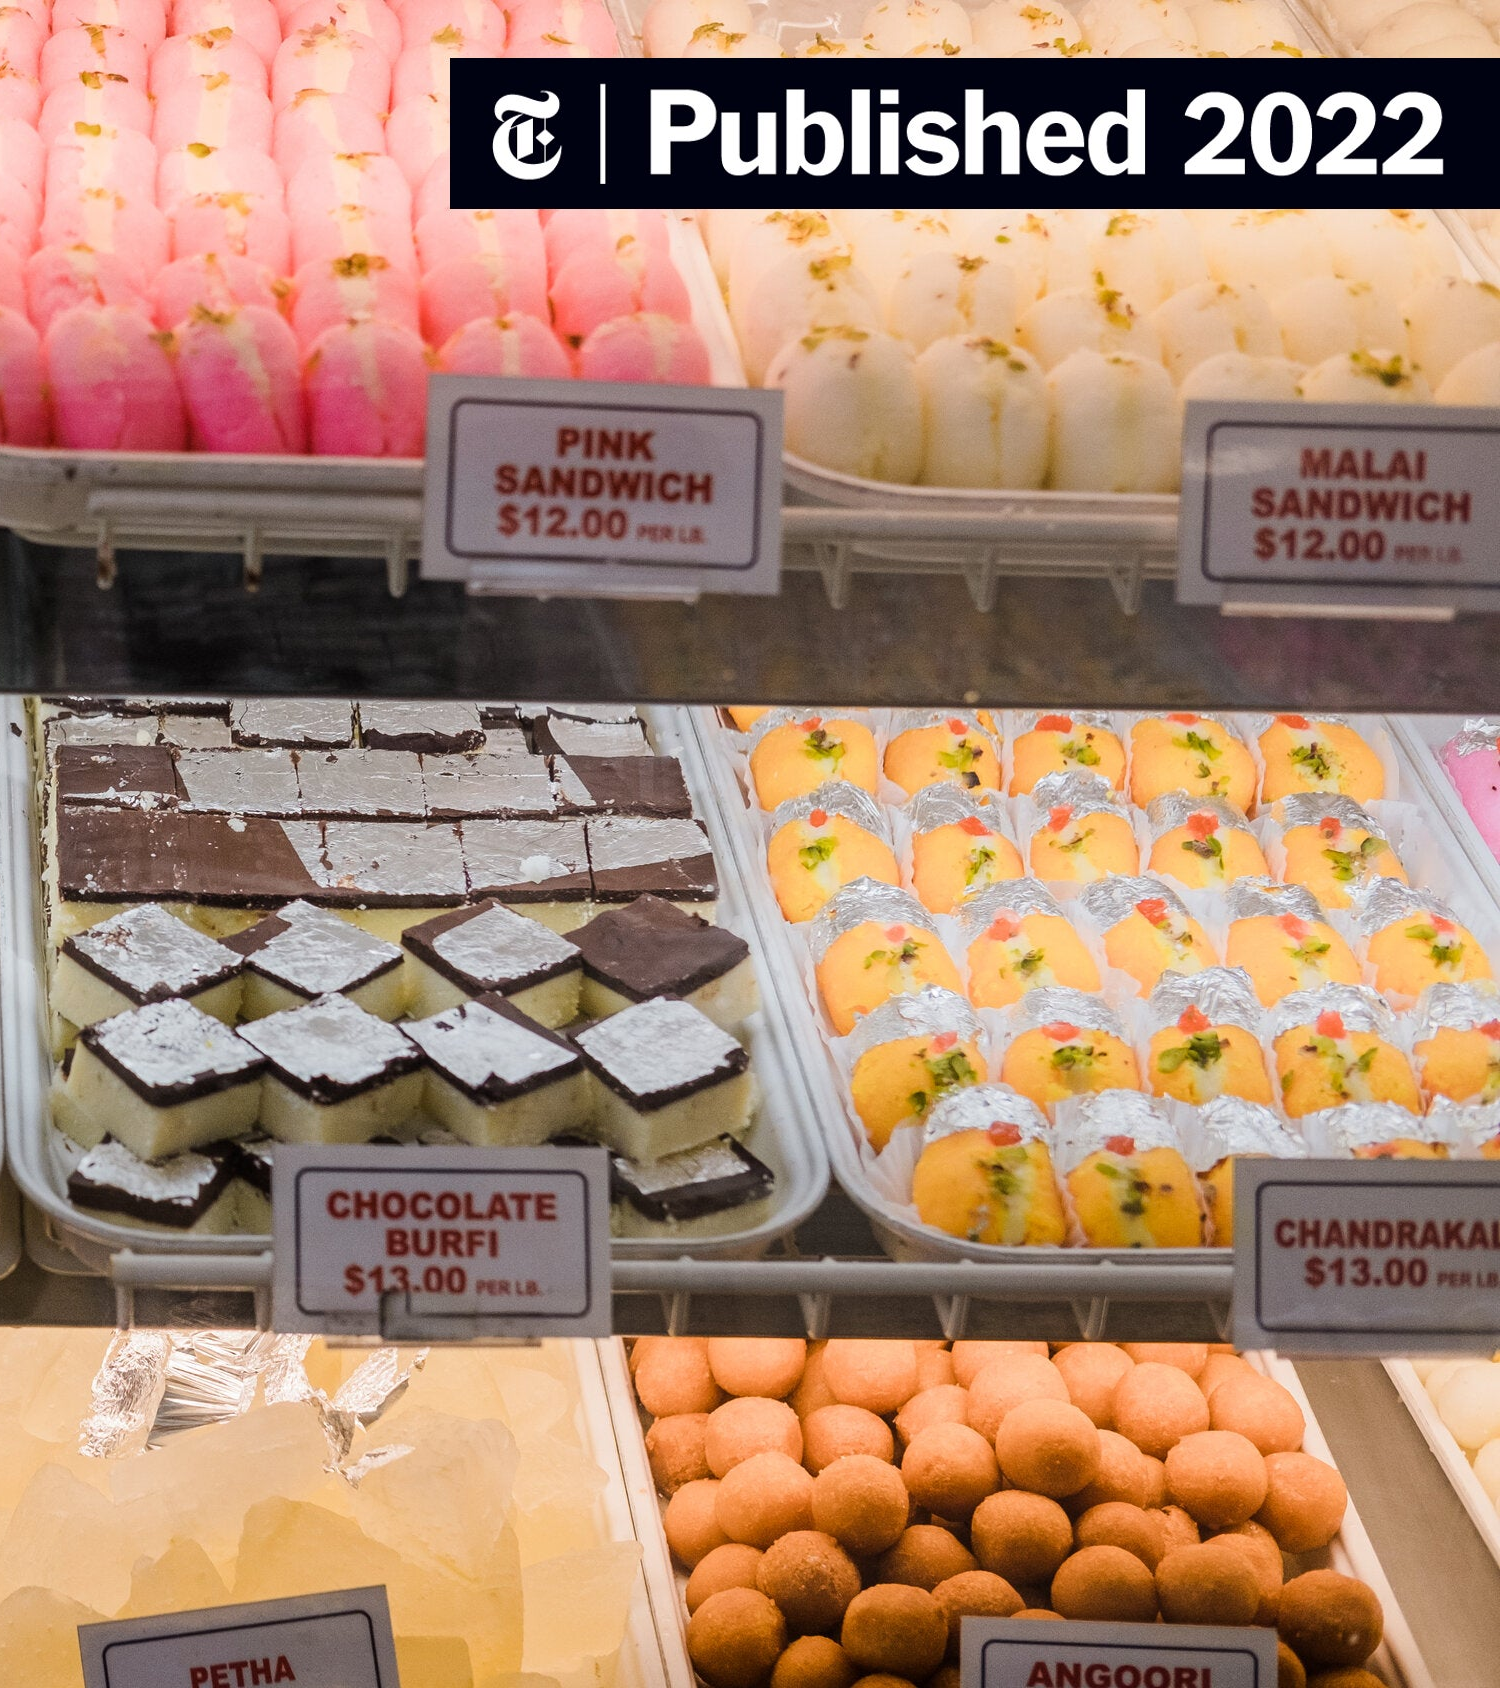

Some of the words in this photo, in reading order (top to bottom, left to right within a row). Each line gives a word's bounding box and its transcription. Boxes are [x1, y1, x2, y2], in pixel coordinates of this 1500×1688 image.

[556, 426, 654, 461] PINK
[1299, 447, 1427, 482] MALAI
[495, 463, 714, 505] SANDWICH
[1252, 487, 1472, 523] SANDWICH
[498, 502, 629, 541] $12.00
[636, 524, 677, 543] PER
[1254, 526, 1387, 562] $12.00
[326, 1190, 557, 1223] CHOCOLATE
[386, 1228, 499, 1258] BURFI
[344, 1264, 468, 1296] $13.00
[475, 1280, 512, 1296] PER
[1305, 1255, 1430, 1289] $13.00
[1437, 1271, 1472, 1288] PER
[190, 1655, 295, 1688] PETHA
[1027, 1661, 1211, 1688] ANGOORI
